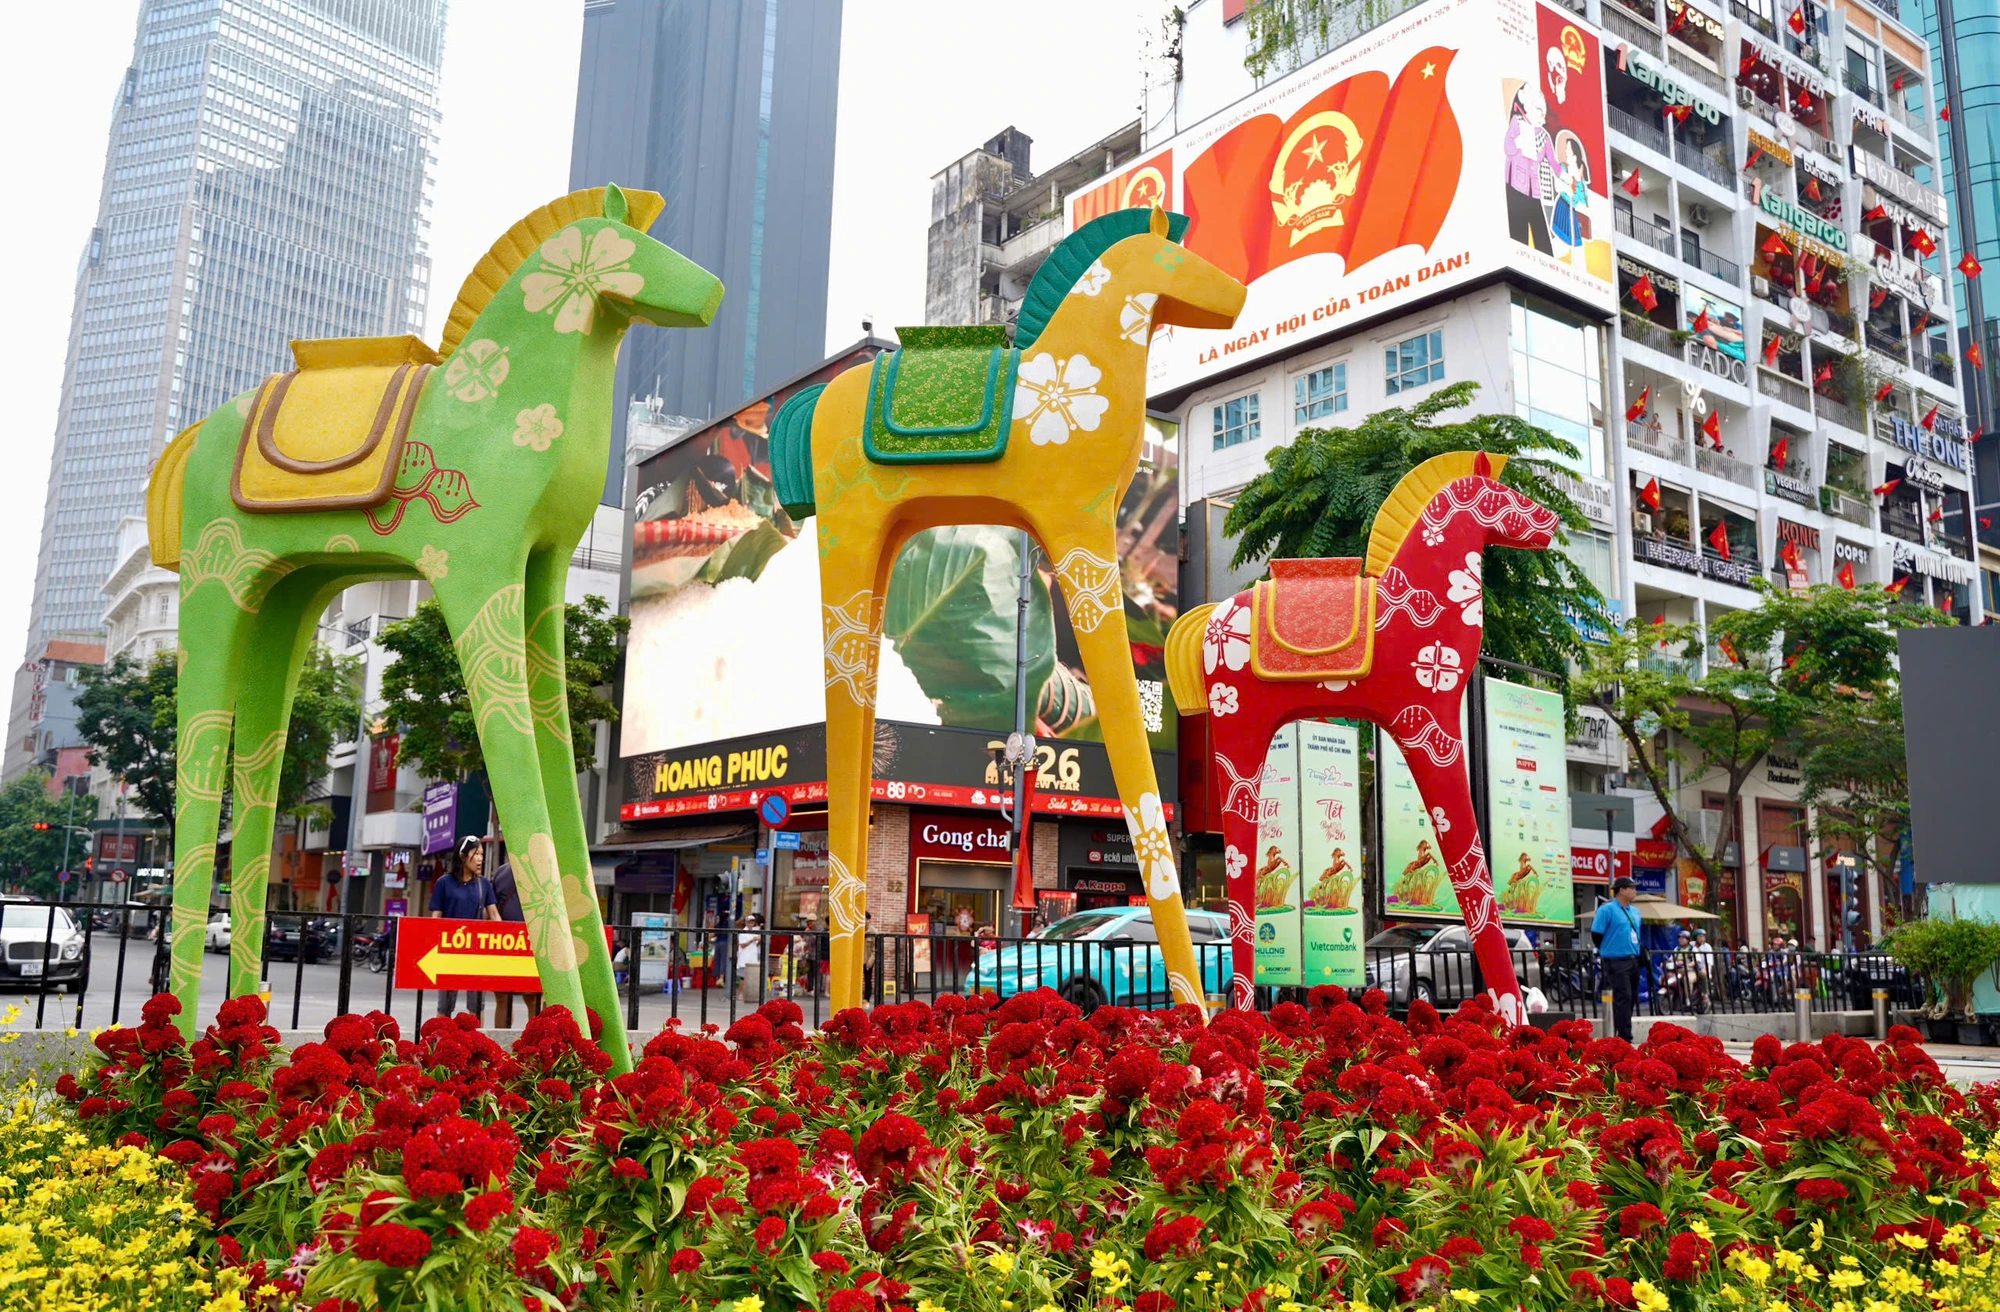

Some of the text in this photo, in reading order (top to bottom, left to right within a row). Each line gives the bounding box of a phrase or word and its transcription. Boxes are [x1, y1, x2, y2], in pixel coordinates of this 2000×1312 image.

[1199, 346, 1218, 365] LÀ
[1224, 327, 1270, 356] NGÀY
[1276, 314, 1307, 334] HỘI
[1312, 297, 1351, 321] CỦA
[1357, 274, 1411, 305] TOÀN
[1417, 251, 1471, 283] DÂN!
[1688, 341, 1749, 387] FADO
[1890, 416, 1968, 471] THE ONE
[1649, 541, 1709, 574] MERAKI
[1836, 542, 1868, 565] OOPS!
[1915, 552, 1968, 586] DOWNTOWN
[655, 744, 788, 793] HOANG PHUC
[1768, 770, 1800, 785] Bookstore
[1052, 779, 1080, 792] YEAR
[1260, 798, 1281, 820] Tết
[1316, 799, 1345, 821] Tết
[923, 824, 1008, 852] Gong cha
[1270, 827, 1283, 839] 26
[1335, 830, 1346, 841] 26
[104, 842, 134, 851] TIERA
[1089, 880, 1126, 892] Kappa
[441, 925, 472, 949] LỐI
[1311, 941, 1357, 952] Vietcombank
